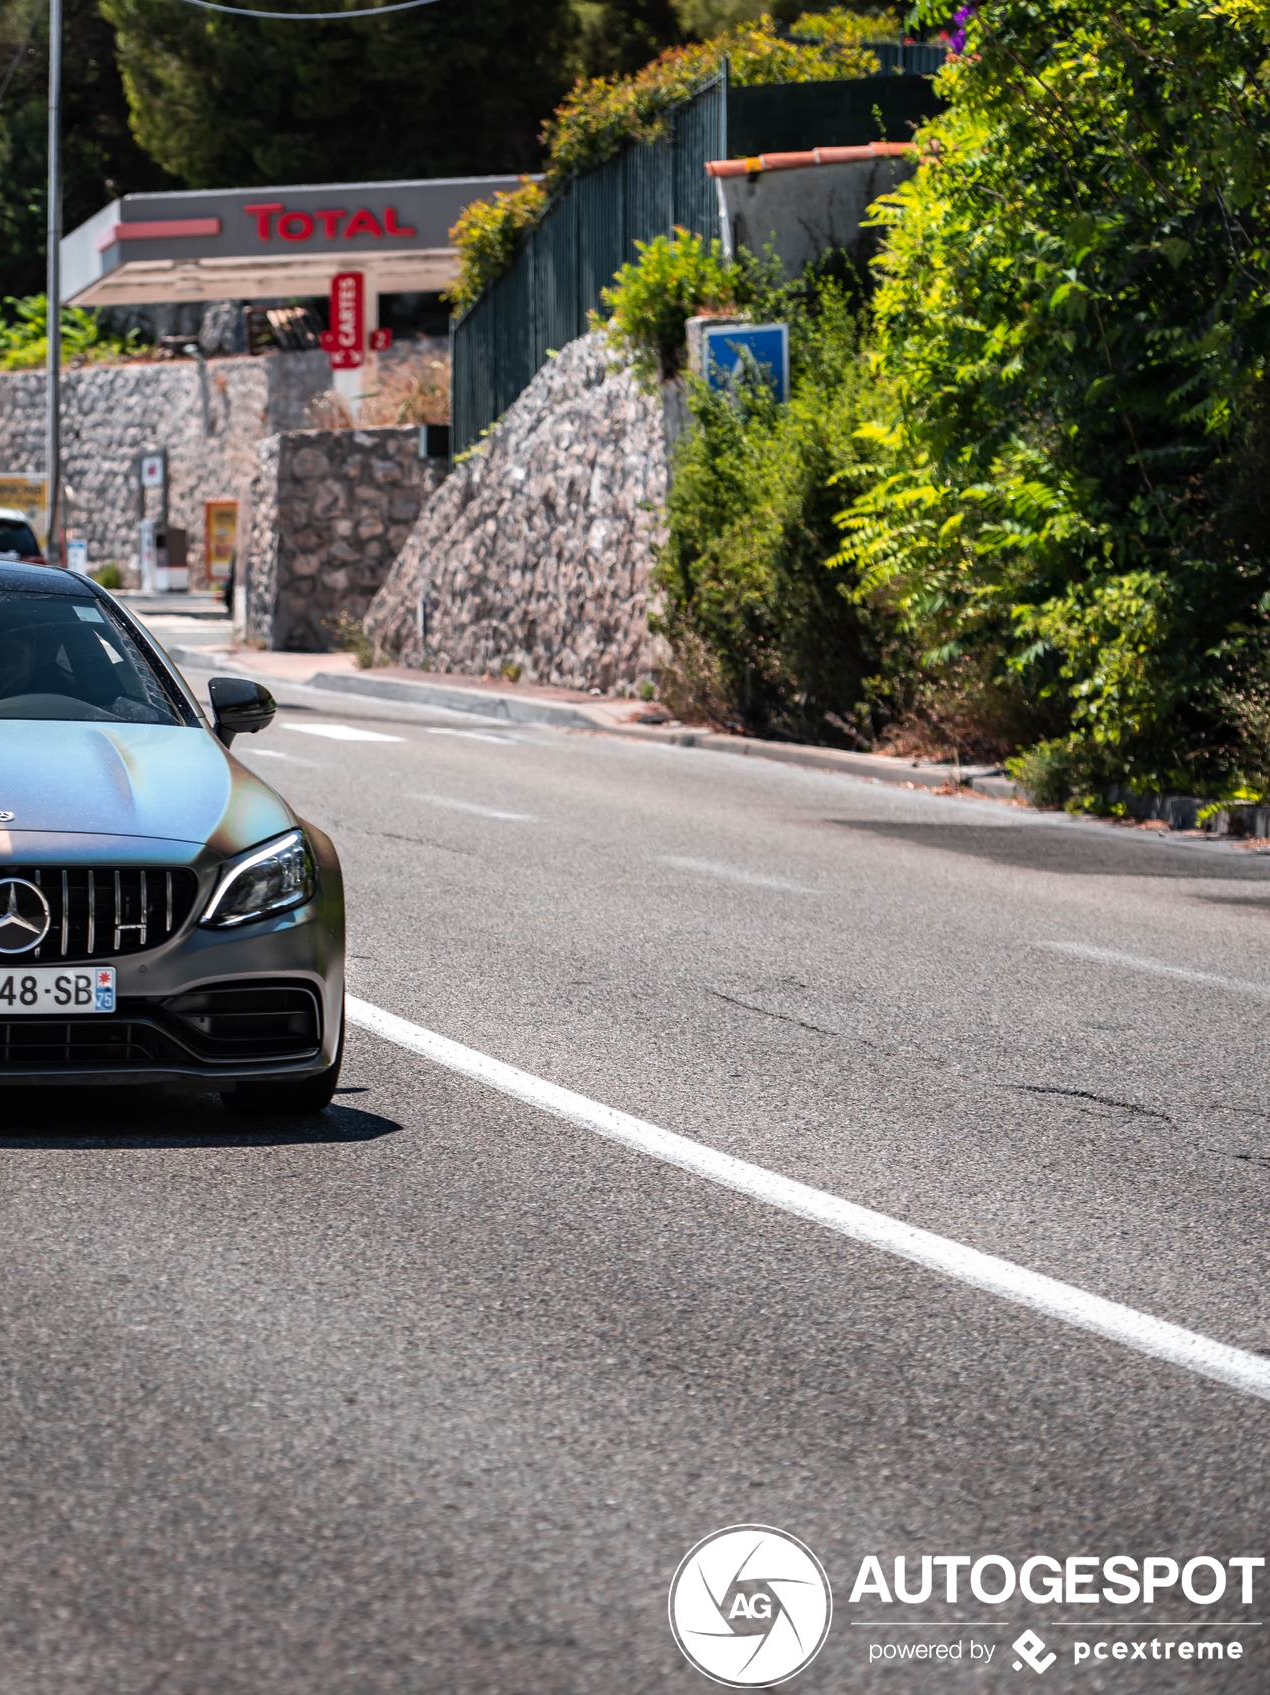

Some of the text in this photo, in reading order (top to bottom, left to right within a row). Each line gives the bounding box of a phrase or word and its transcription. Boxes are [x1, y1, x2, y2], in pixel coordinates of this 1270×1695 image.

[244, 203, 417, 242] TOTAL
[338, 277, 356, 347] CARTES
[96, 992, 113, 1008] 75
